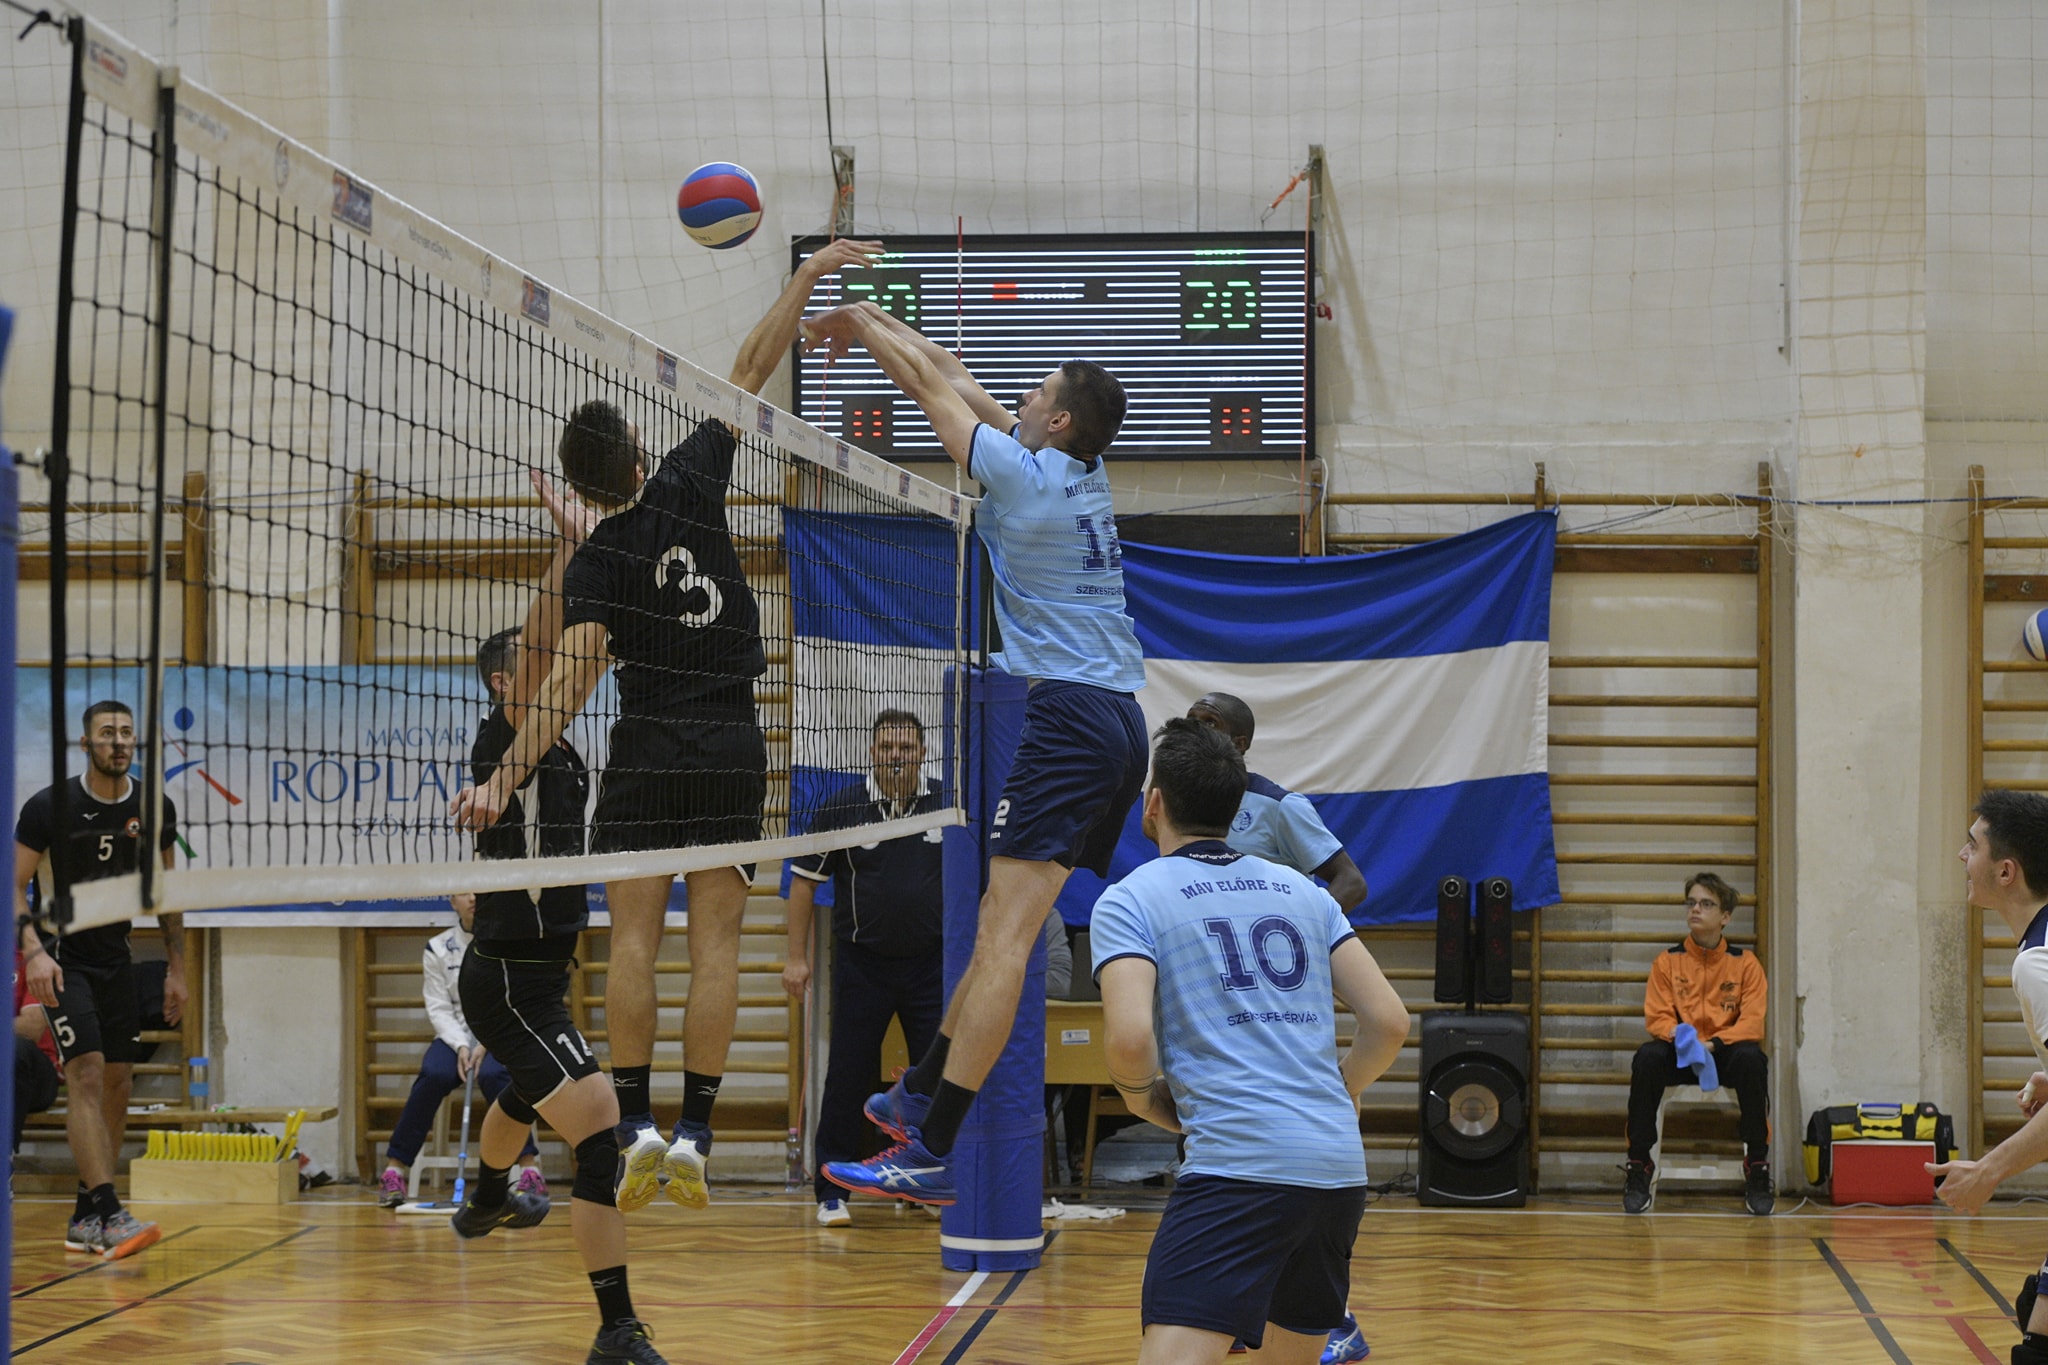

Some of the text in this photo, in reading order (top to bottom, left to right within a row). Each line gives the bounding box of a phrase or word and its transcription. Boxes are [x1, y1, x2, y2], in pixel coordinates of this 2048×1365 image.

[1184, 280, 1257, 329] 20
[655, 545, 723, 629] 3
[365, 726, 468, 748] MAGYAR
[271, 750, 476, 804] RÖPLA
[351, 812, 467, 837] SZÖVETS
[98, 835, 114, 861] 5
[1180, 875, 1292, 900] MÁV ELŐRE SC
[1202, 914, 1309, 992] 10
[54, 1015, 76, 1048] 5
